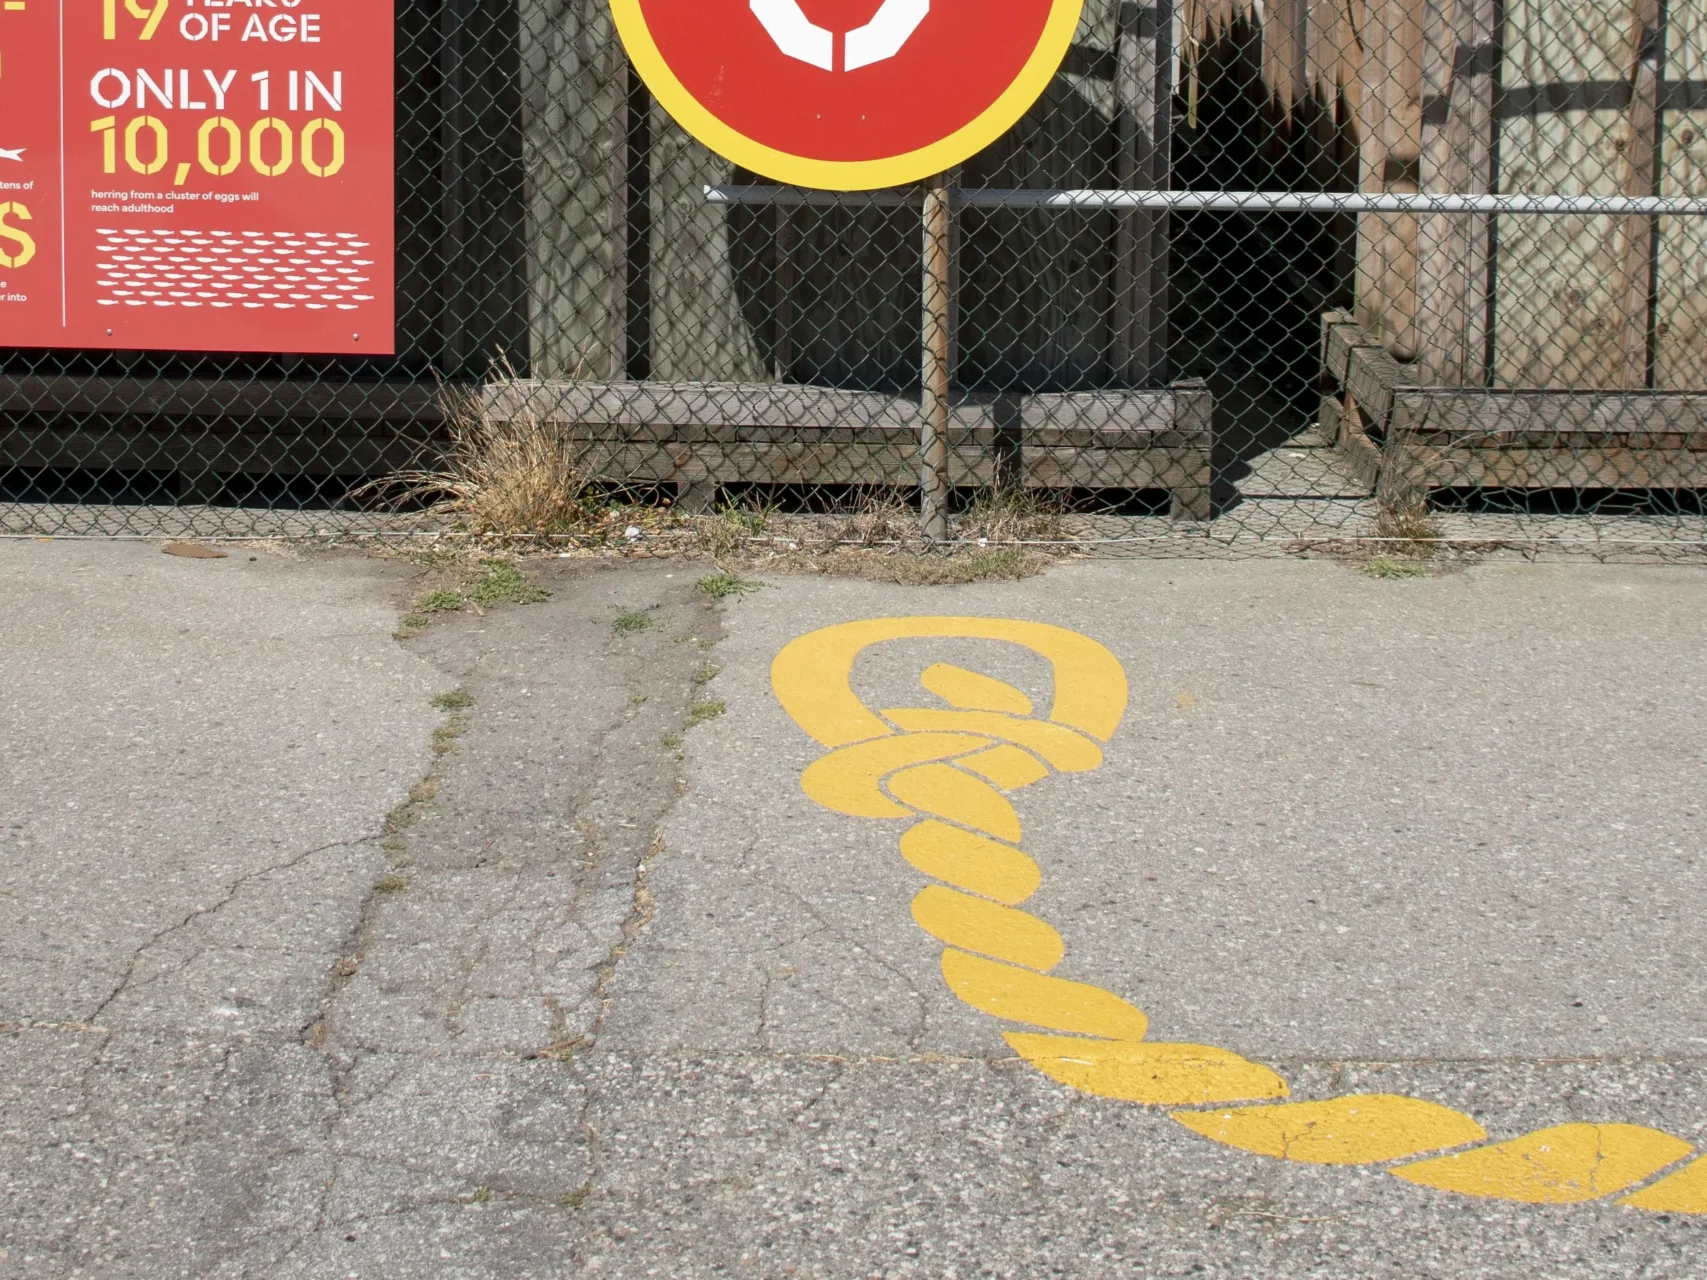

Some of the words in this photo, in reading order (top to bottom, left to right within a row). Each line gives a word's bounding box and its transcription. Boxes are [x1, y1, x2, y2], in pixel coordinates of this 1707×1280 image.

[180, 12, 231, 42] OF
[241, 13, 321, 43] AGE
[90, 67, 238, 110] ONLY
[252, 69, 269, 111] 1
[289, 70, 342, 112] IN
[90, 115, 345, 186] 10,000
[23, 180, 34, 190] of
[91, 190, 128, 200] herring
[130, 190, 154, 200] from
[166, 191, 198, 200] cluster
[202, 191, 212, 200] of
[214, 194, 239, 202] eggs
[242, 192, 258, 201] will
[91, 203, 119, 212] reach
[122, 204, 174, 213] adulthood
[8, 292, 27, 301] into
